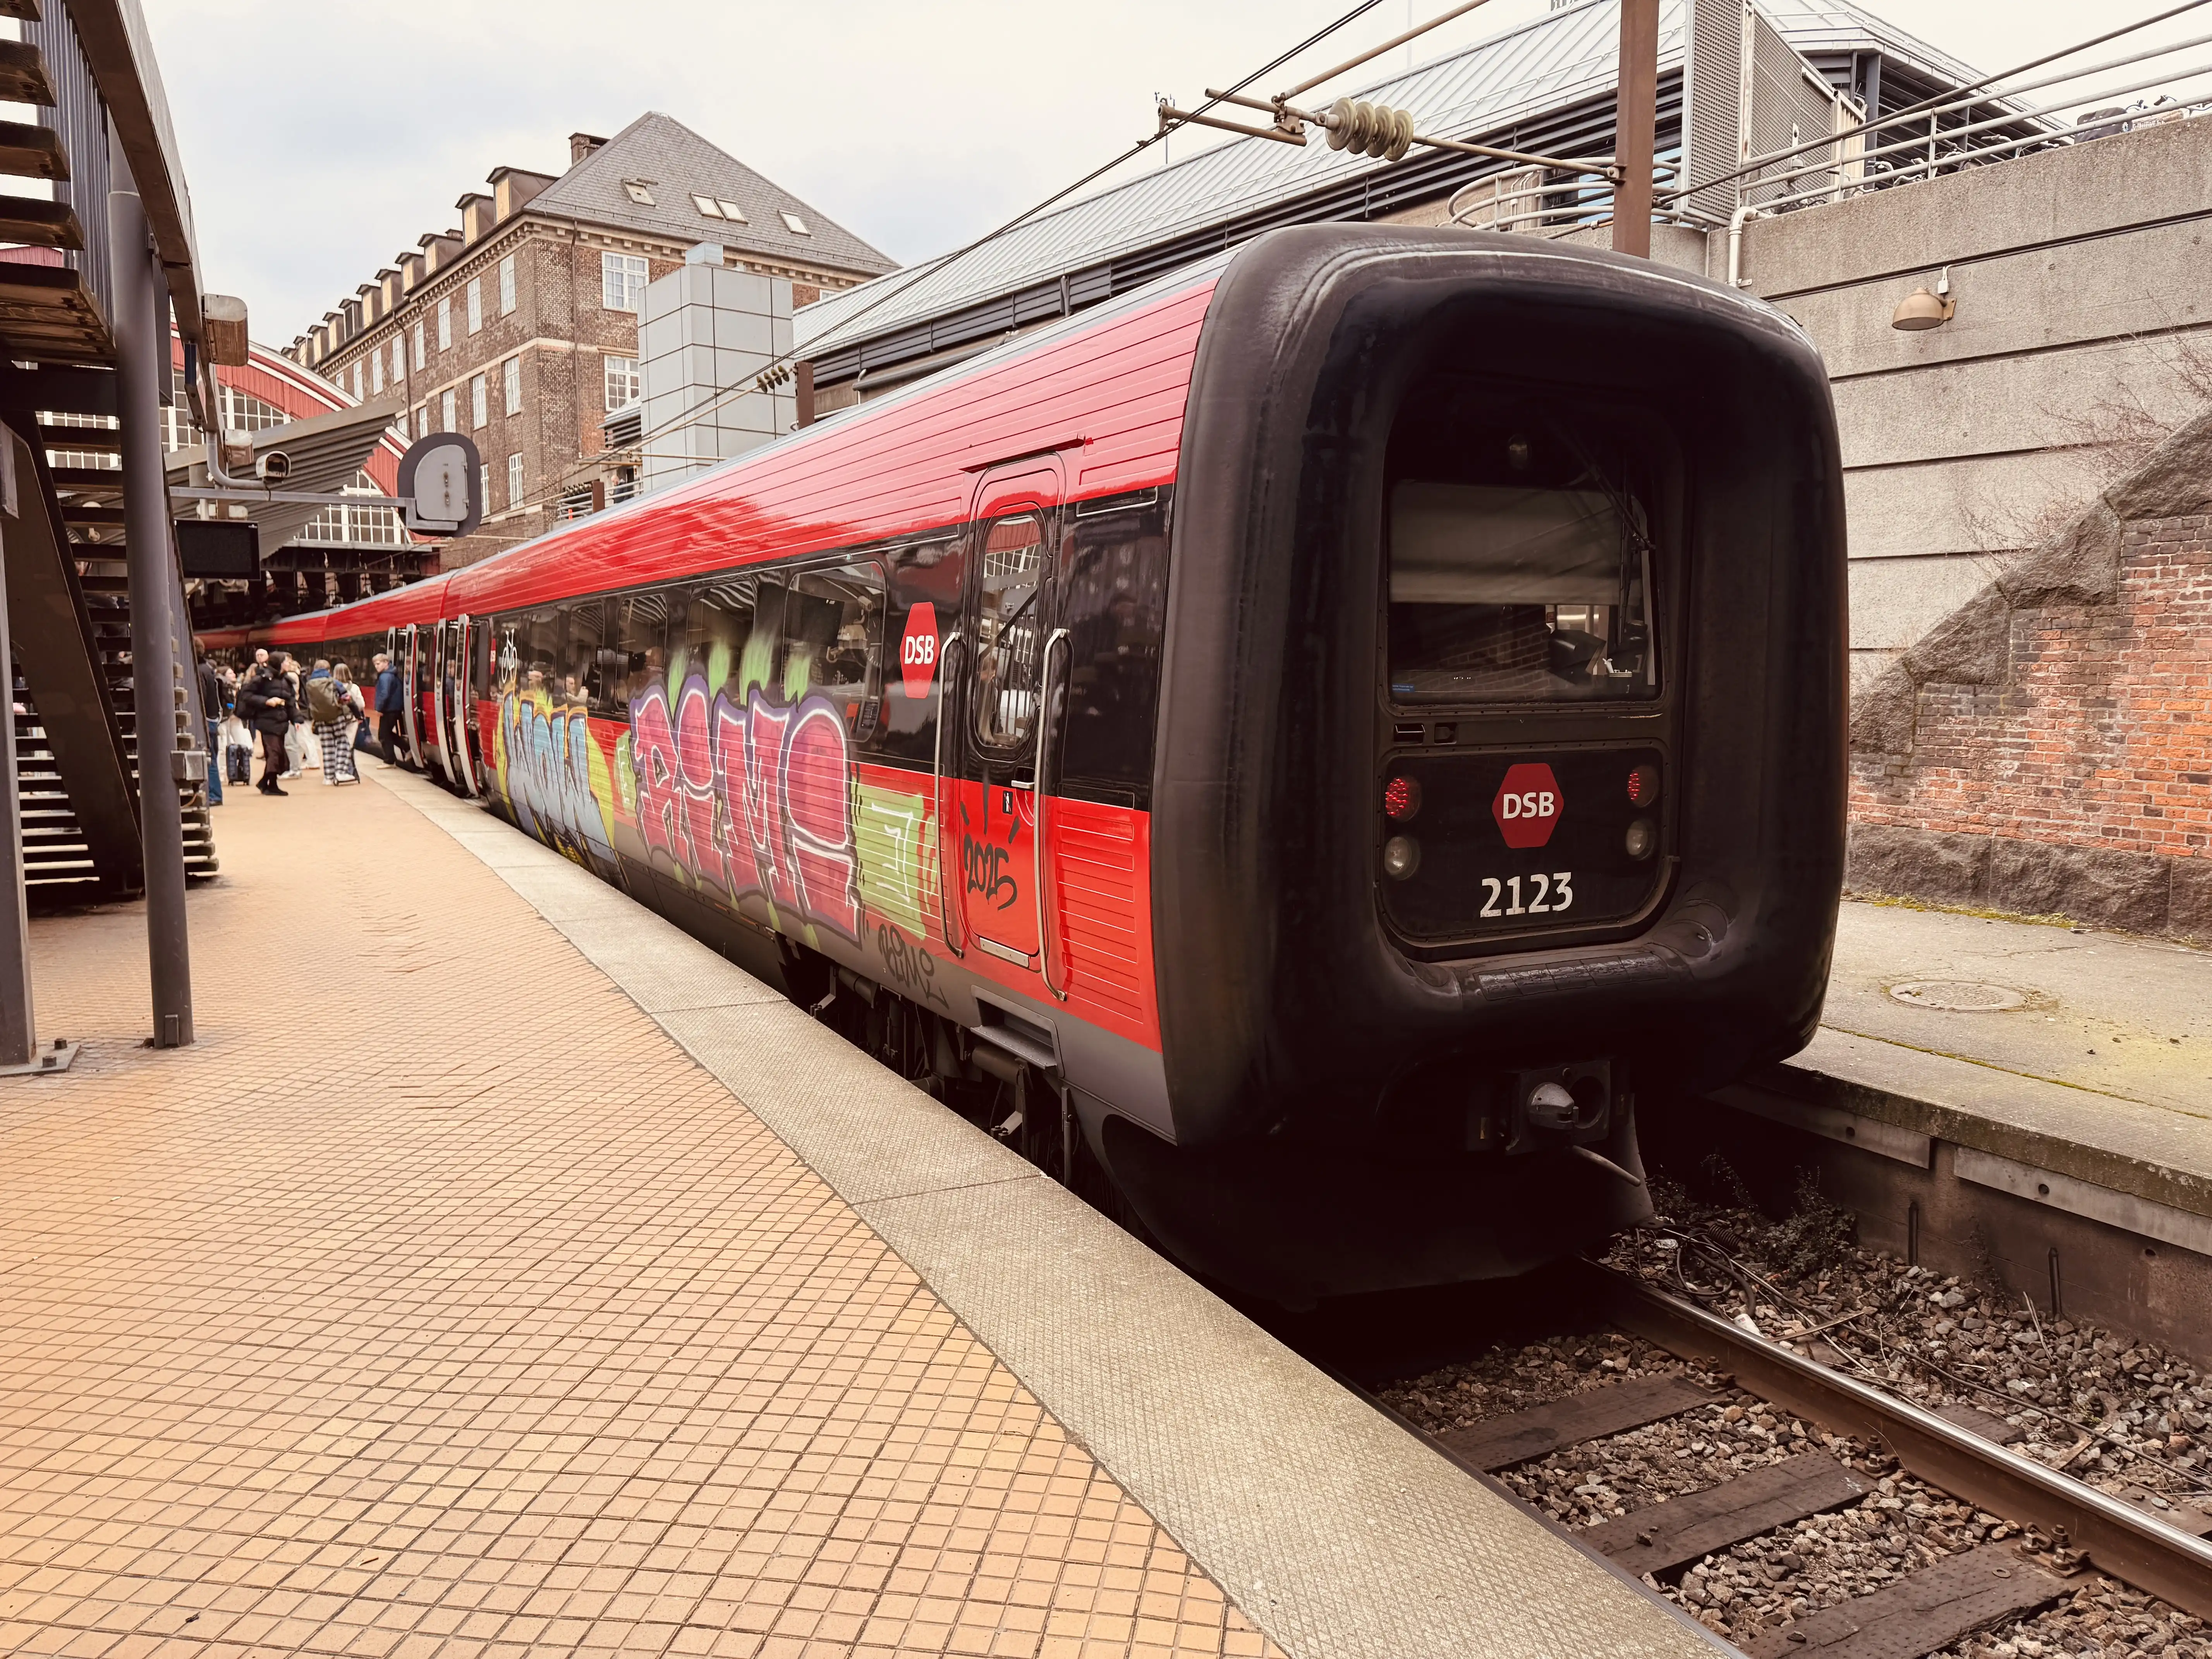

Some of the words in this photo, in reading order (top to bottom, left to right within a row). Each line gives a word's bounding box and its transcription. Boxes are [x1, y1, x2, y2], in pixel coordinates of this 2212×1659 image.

[904, 635, 935, 665] DSB
[1503, 792, 1554, 819] DSB
[963, 833, 1018, 911] 2025
[1480, 872, 1573, 917] 2123
